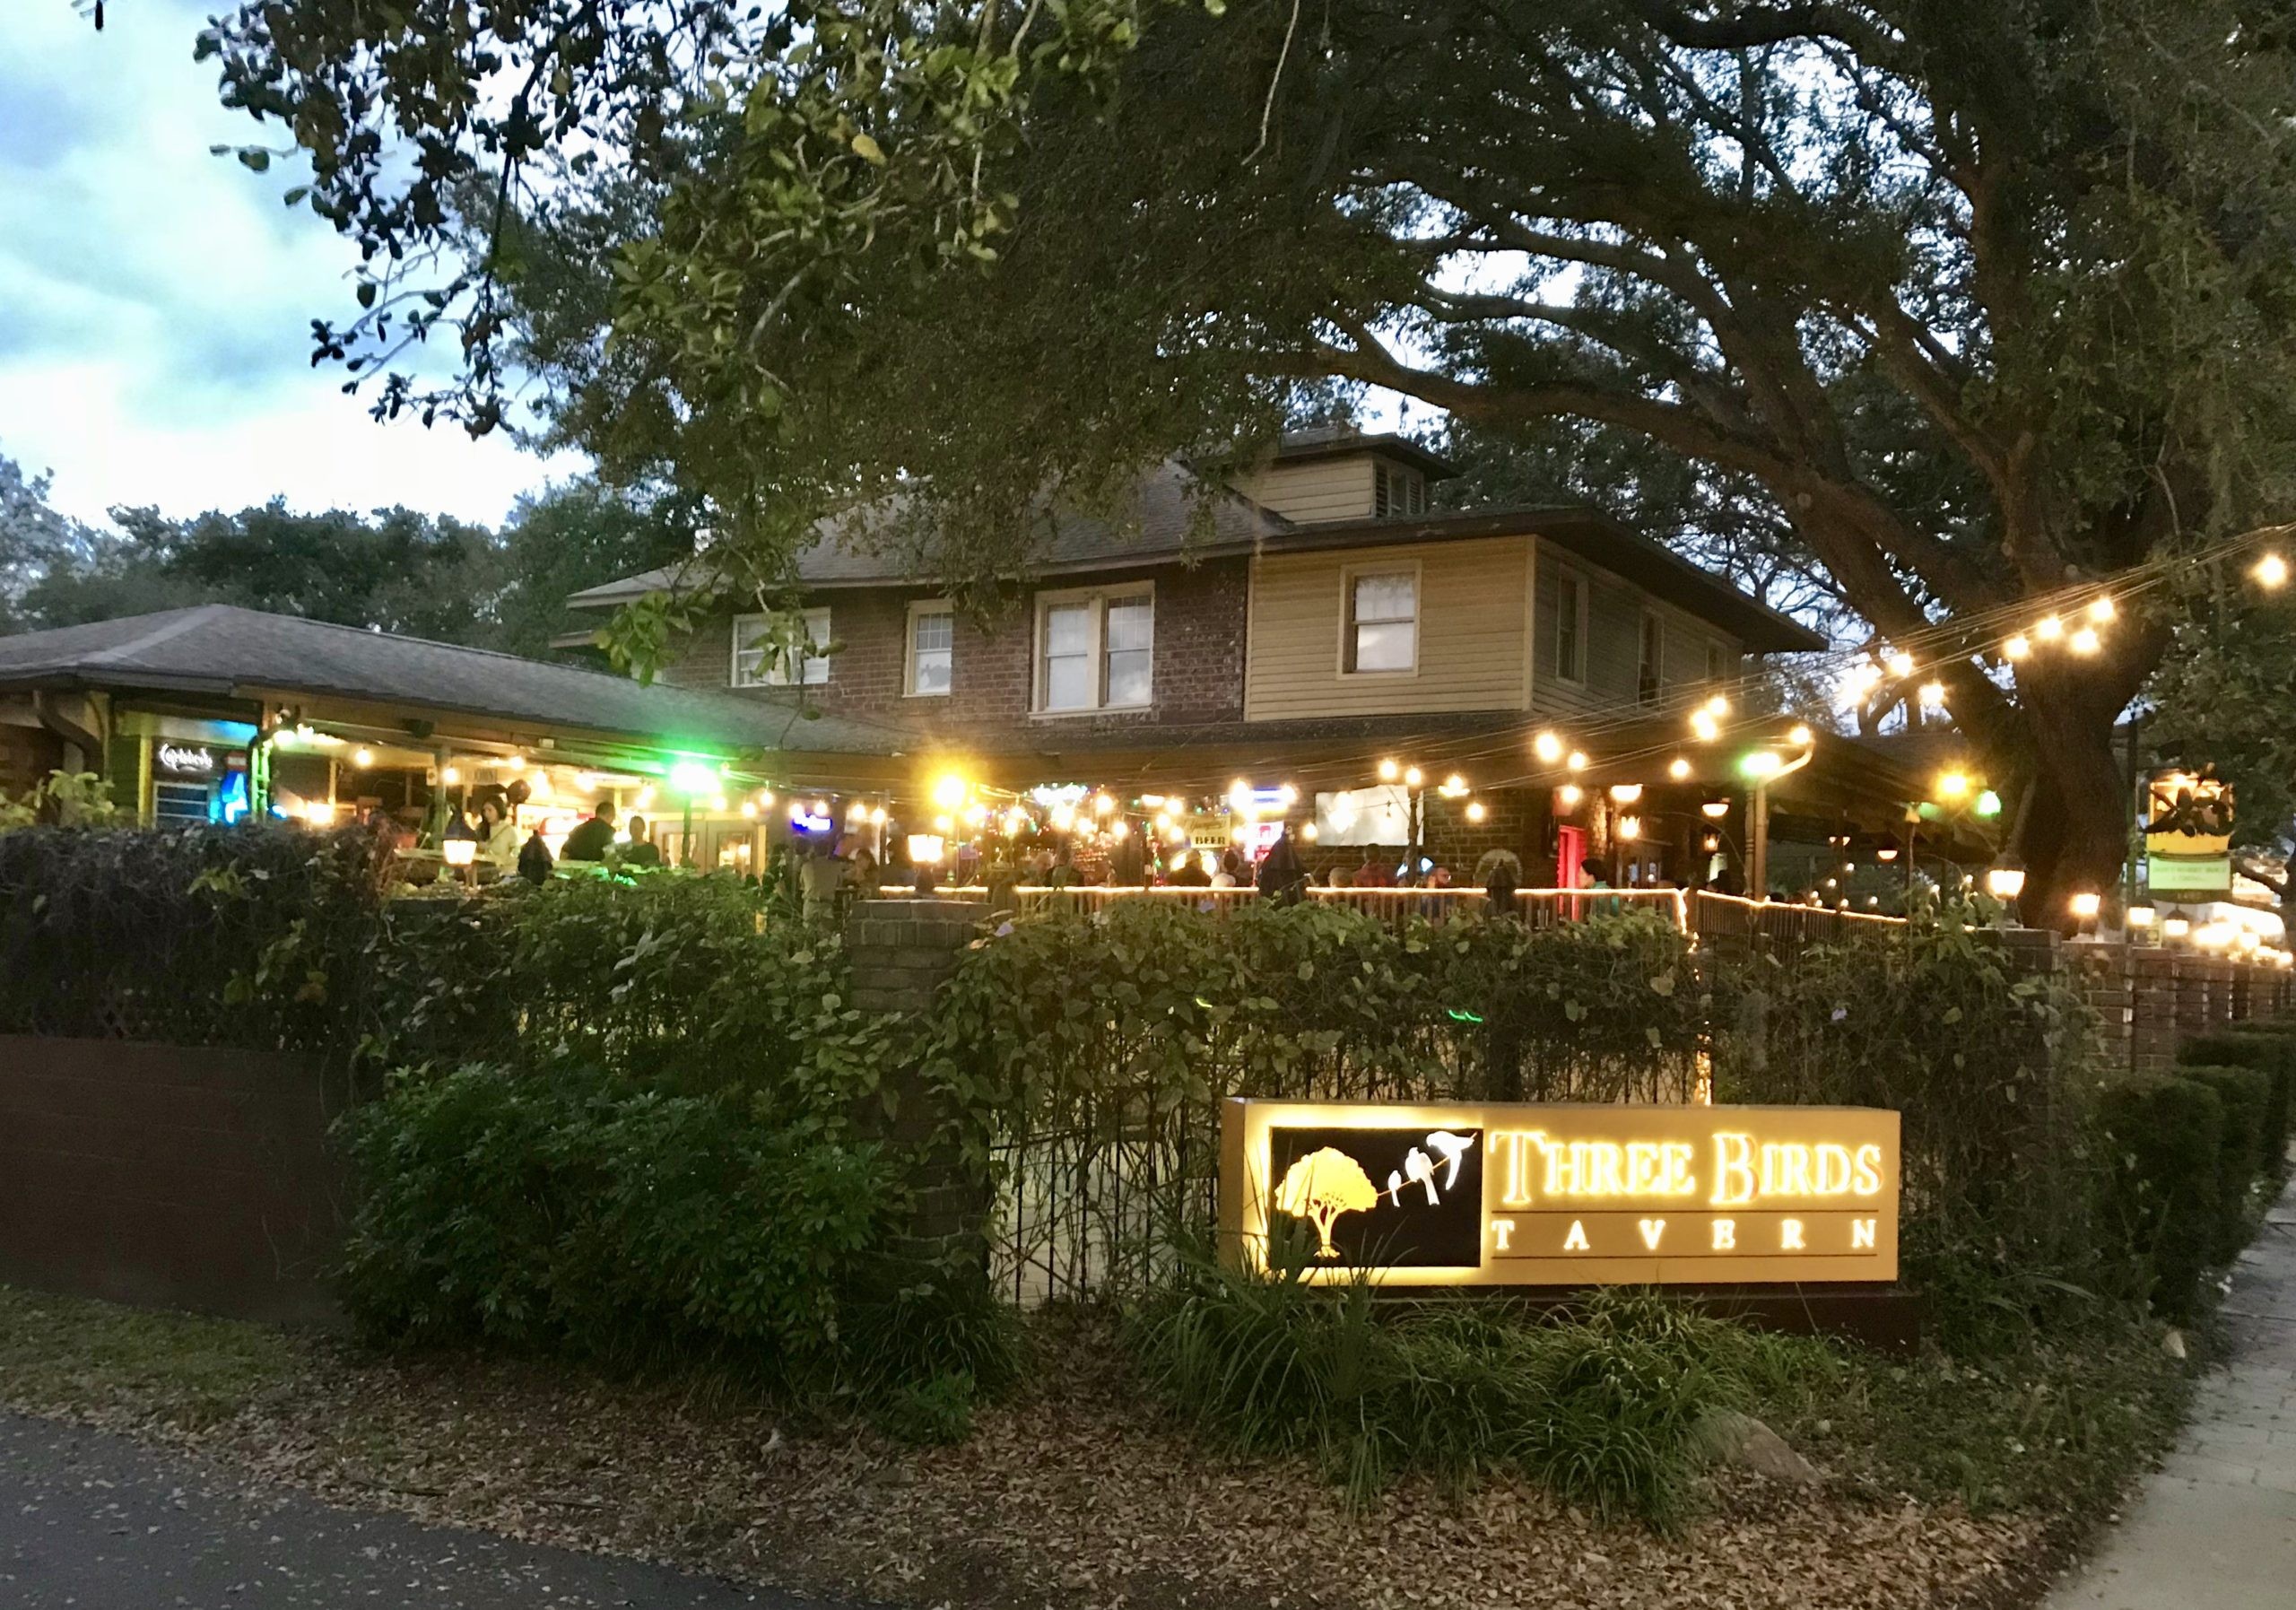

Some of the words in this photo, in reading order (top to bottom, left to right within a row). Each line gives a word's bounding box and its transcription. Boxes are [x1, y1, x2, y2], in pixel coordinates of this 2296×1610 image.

[1195, 836, 1226, 844] BEER
[1489, 1130, 1696, 1205] THREE
[1709, 1131, 1884, 1205] BIRDS
[1491, 1218, 1877, 1250] TAVERN
